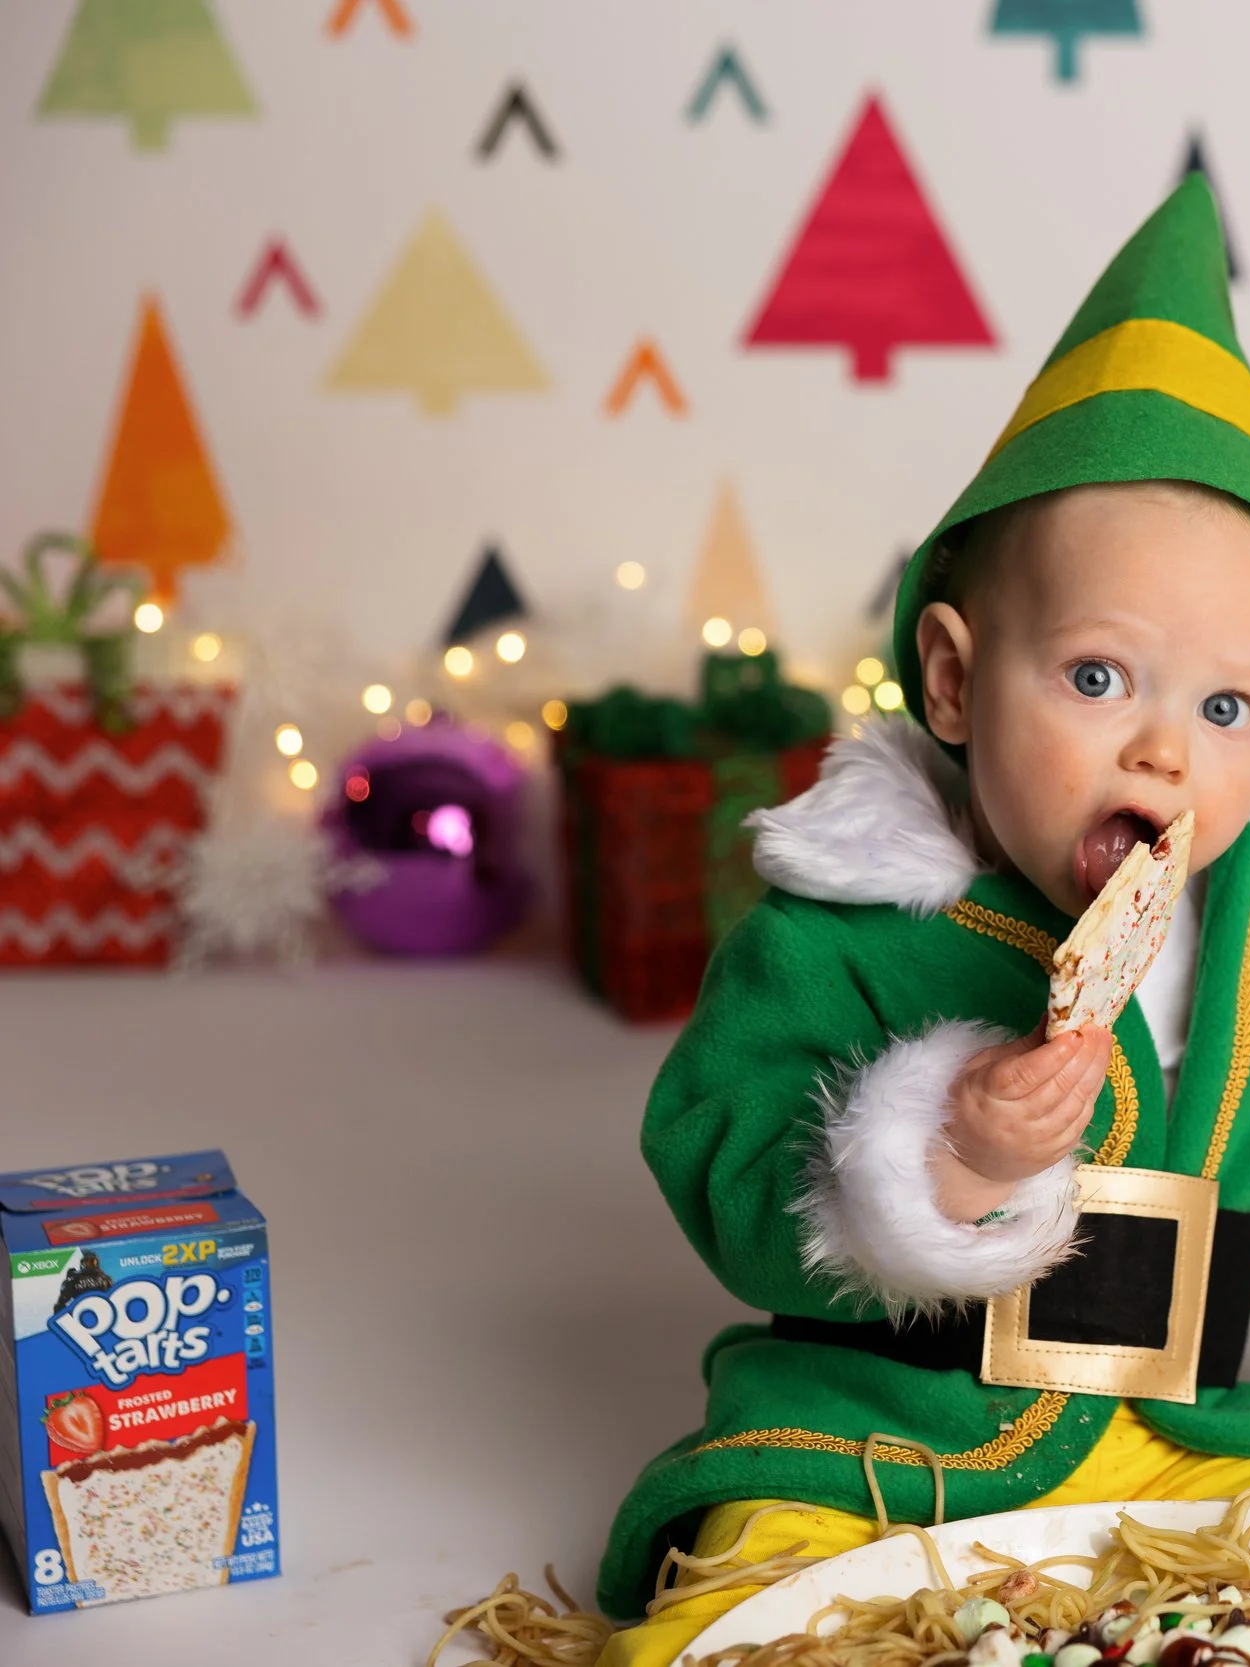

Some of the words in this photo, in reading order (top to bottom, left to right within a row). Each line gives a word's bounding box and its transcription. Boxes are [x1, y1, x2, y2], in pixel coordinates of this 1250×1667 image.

[31, 1259, 59, 1271] XBOX
[120, 1253, 163, 1268] UNLOCK
[162, 1239, 216, 1266] 2XP
[93, 1326, 210, 1385] tarts
[109, 1389, 238, 1430] STRAWBERRY
[118, 1390, 173, 1410] FROSTED
[34, 1549, 64, 1585] 8
